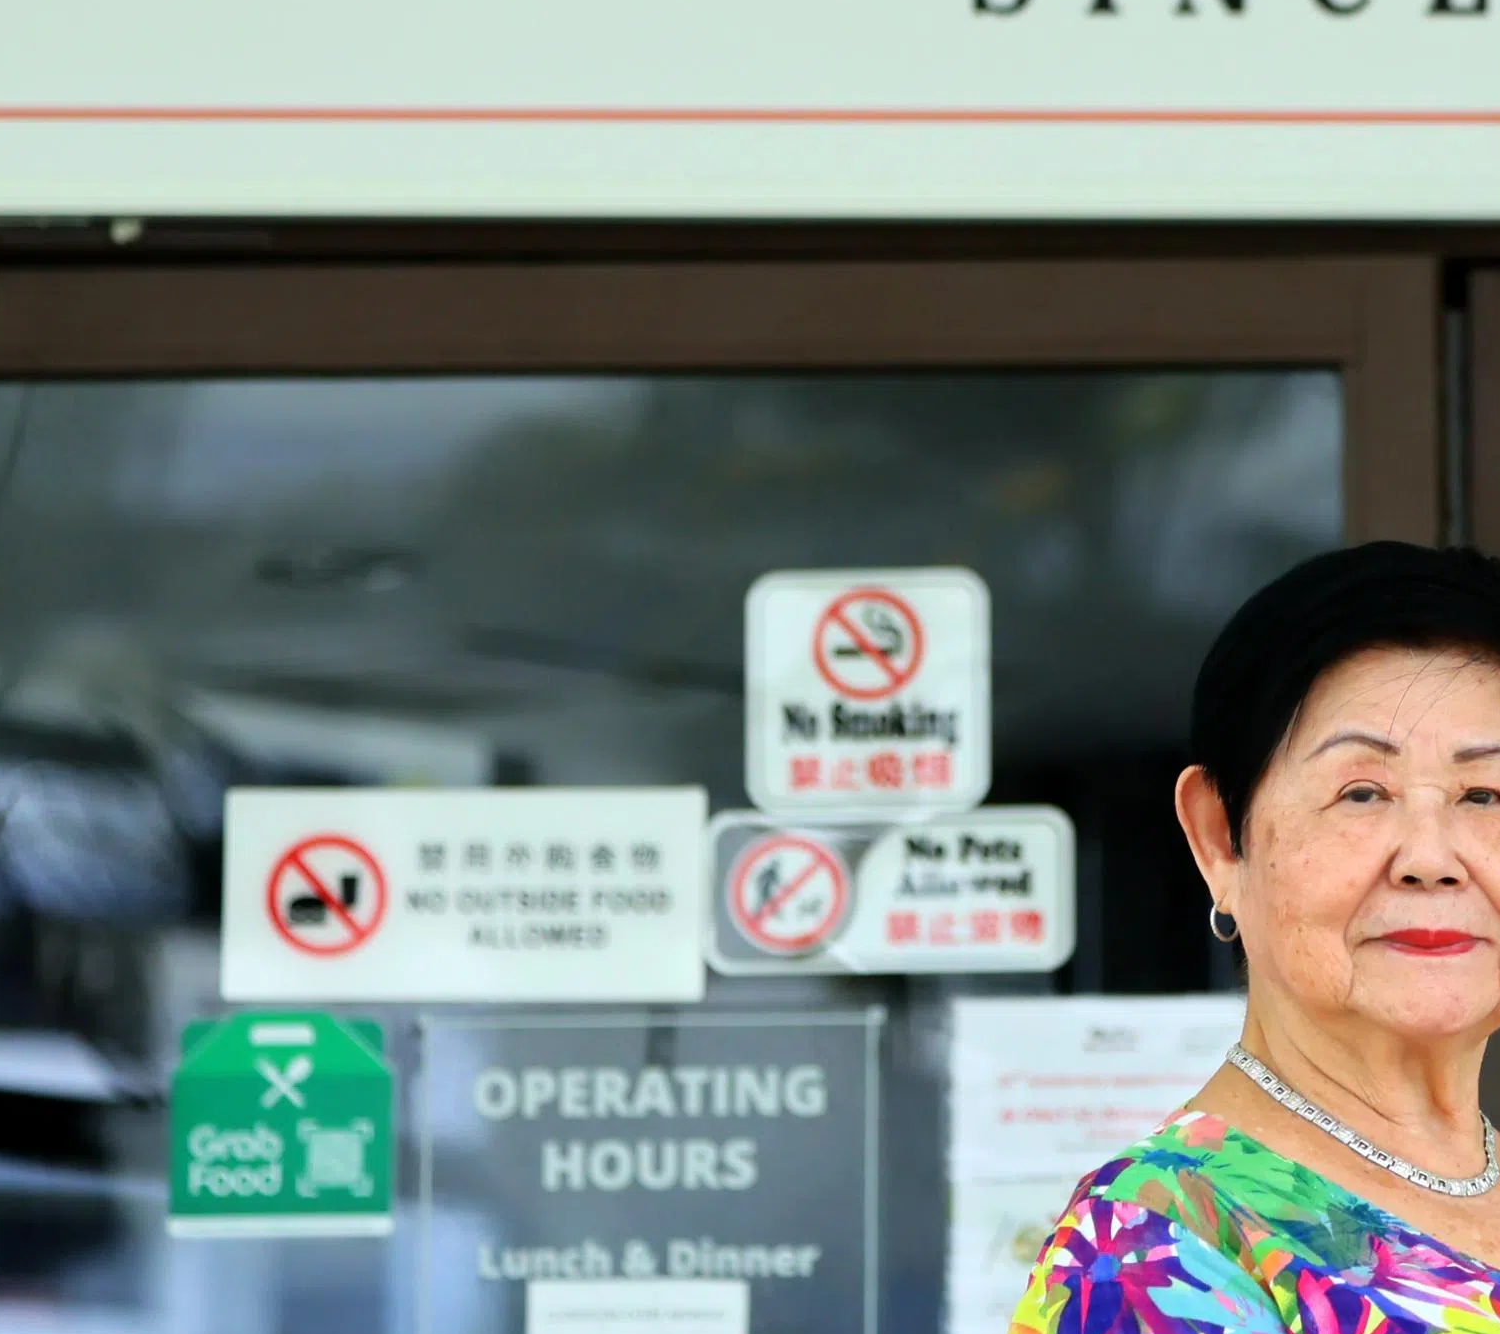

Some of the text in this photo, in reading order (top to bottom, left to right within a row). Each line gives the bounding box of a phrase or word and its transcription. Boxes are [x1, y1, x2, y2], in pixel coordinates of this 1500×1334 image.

[783, 703, 956, 744] No Smoking
[905, 835, 1022, 861] No Pets
[407, 890, 671, 912] NO OUTSIDE FOOD
[902, 870, 1032, 897] Allowed
[472, 925, 604, 946] ALLOWED
[474, 1066, 826, 1119] OPERATING
[188, 1124, 284, 1163] Grab
[189, 1162, 283, 1198] Food
[543, 1139, 756, 1191] HOURS
[478, 1238, 820, 1280] Lunch & Dinner
